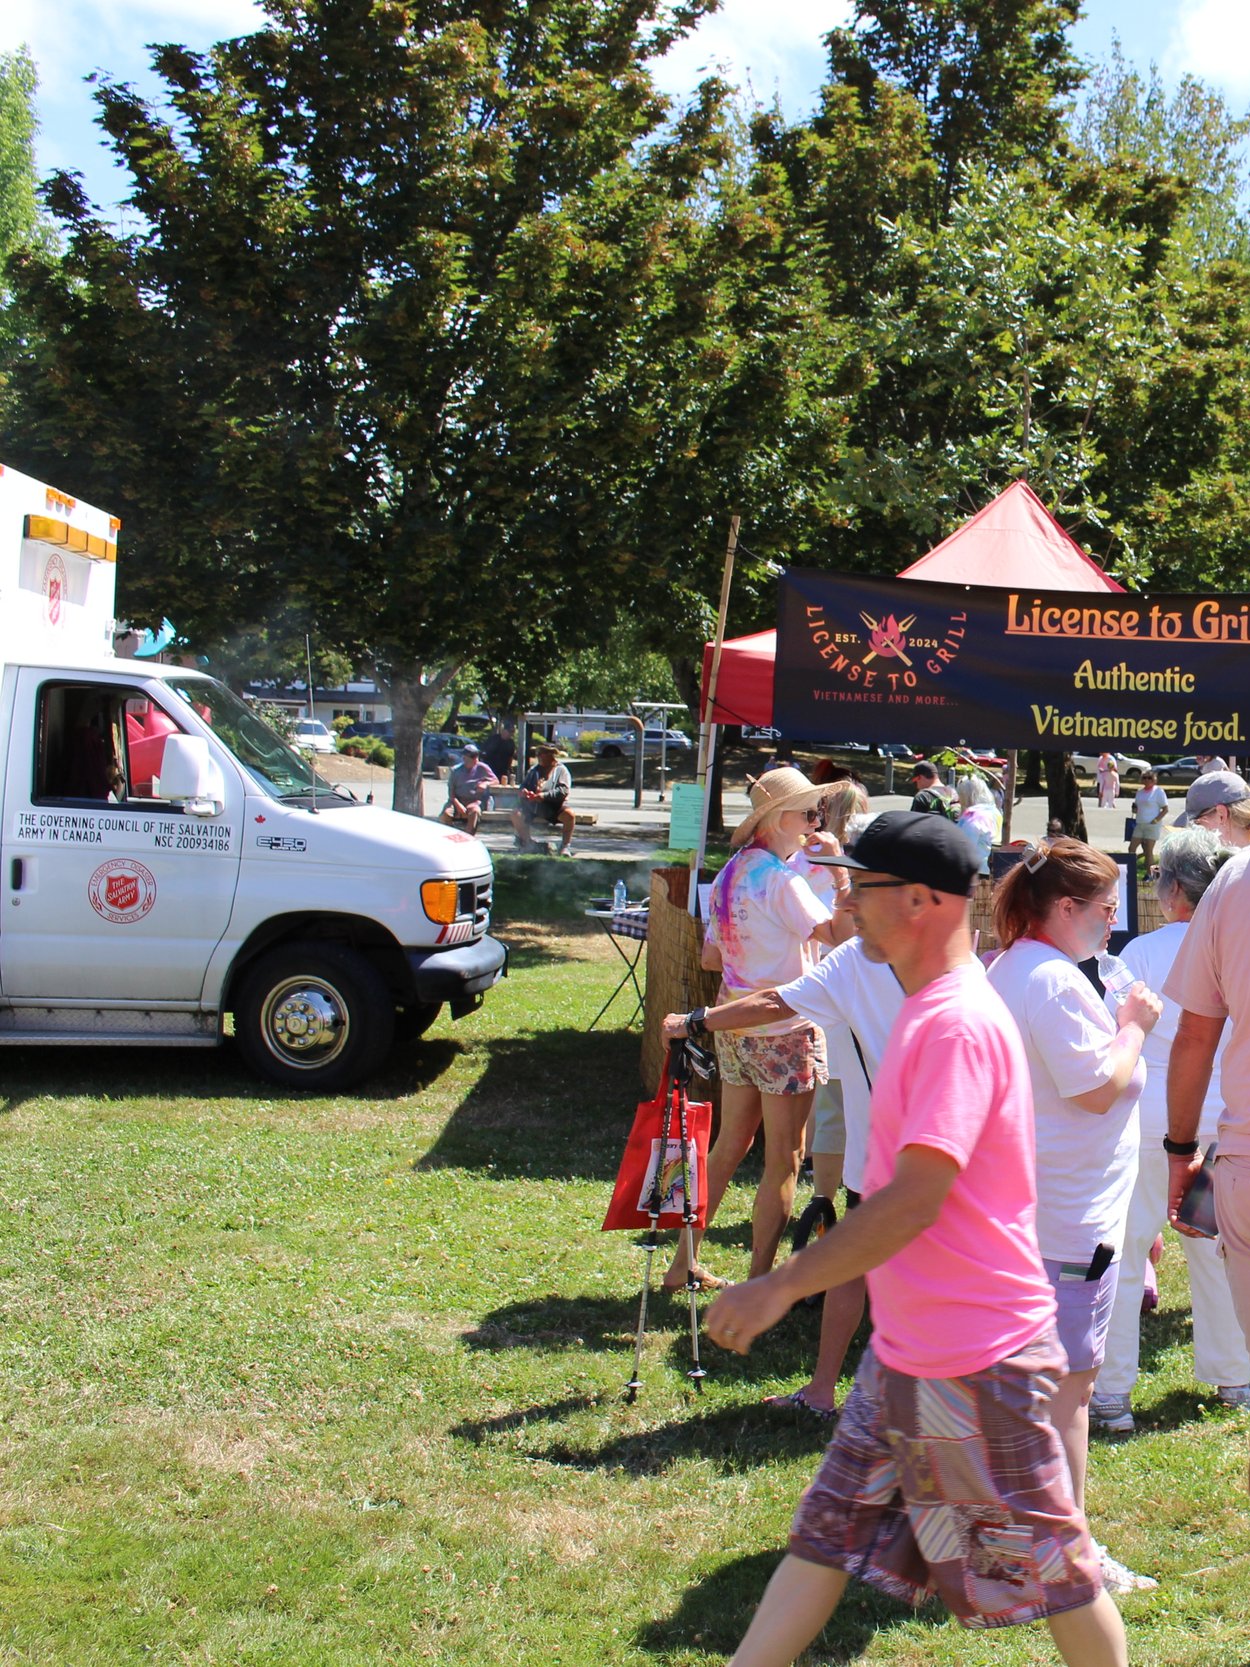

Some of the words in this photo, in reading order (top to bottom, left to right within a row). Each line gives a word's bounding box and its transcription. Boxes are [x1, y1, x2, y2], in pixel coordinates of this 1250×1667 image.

[1007, 594, 1139, 636] License
[1149, 605, 1183, 638] to
[834, 633, 861, 644] EST.
[908, 638, 938, 649] 2024
[806, 605, 878, 688] LICENSE
[887, 670, 917, 692] TO
[926, 611, 968, 675] GRILL
[1073, 659, 1196, 693] Authentic
[888, 694, 910, 705] AND
[1030, 704, 1178, 739] Vietnamese
[1183, 711, 1246, 747] food.
[19, 813, 36, 827] THE
[40, 814, 95, 830] GOVERNING
[98, 818, 140, 833] COUNCIL
[143, 821, 155, 834] OF
[159, 821, 176, 835] THE
[178, 823, 231, 838] SALVATION
[17, 827, 46, 840] ARMY
[49, 829, 59, 841] IN
[62, 830, 103, 843] CANADA
[154, 835, 173, 848] NSC
[176, 836, 230, 852] 200934186
[112, 877, 126, 890] THE
[117, 890, 136, 907] ARMY
